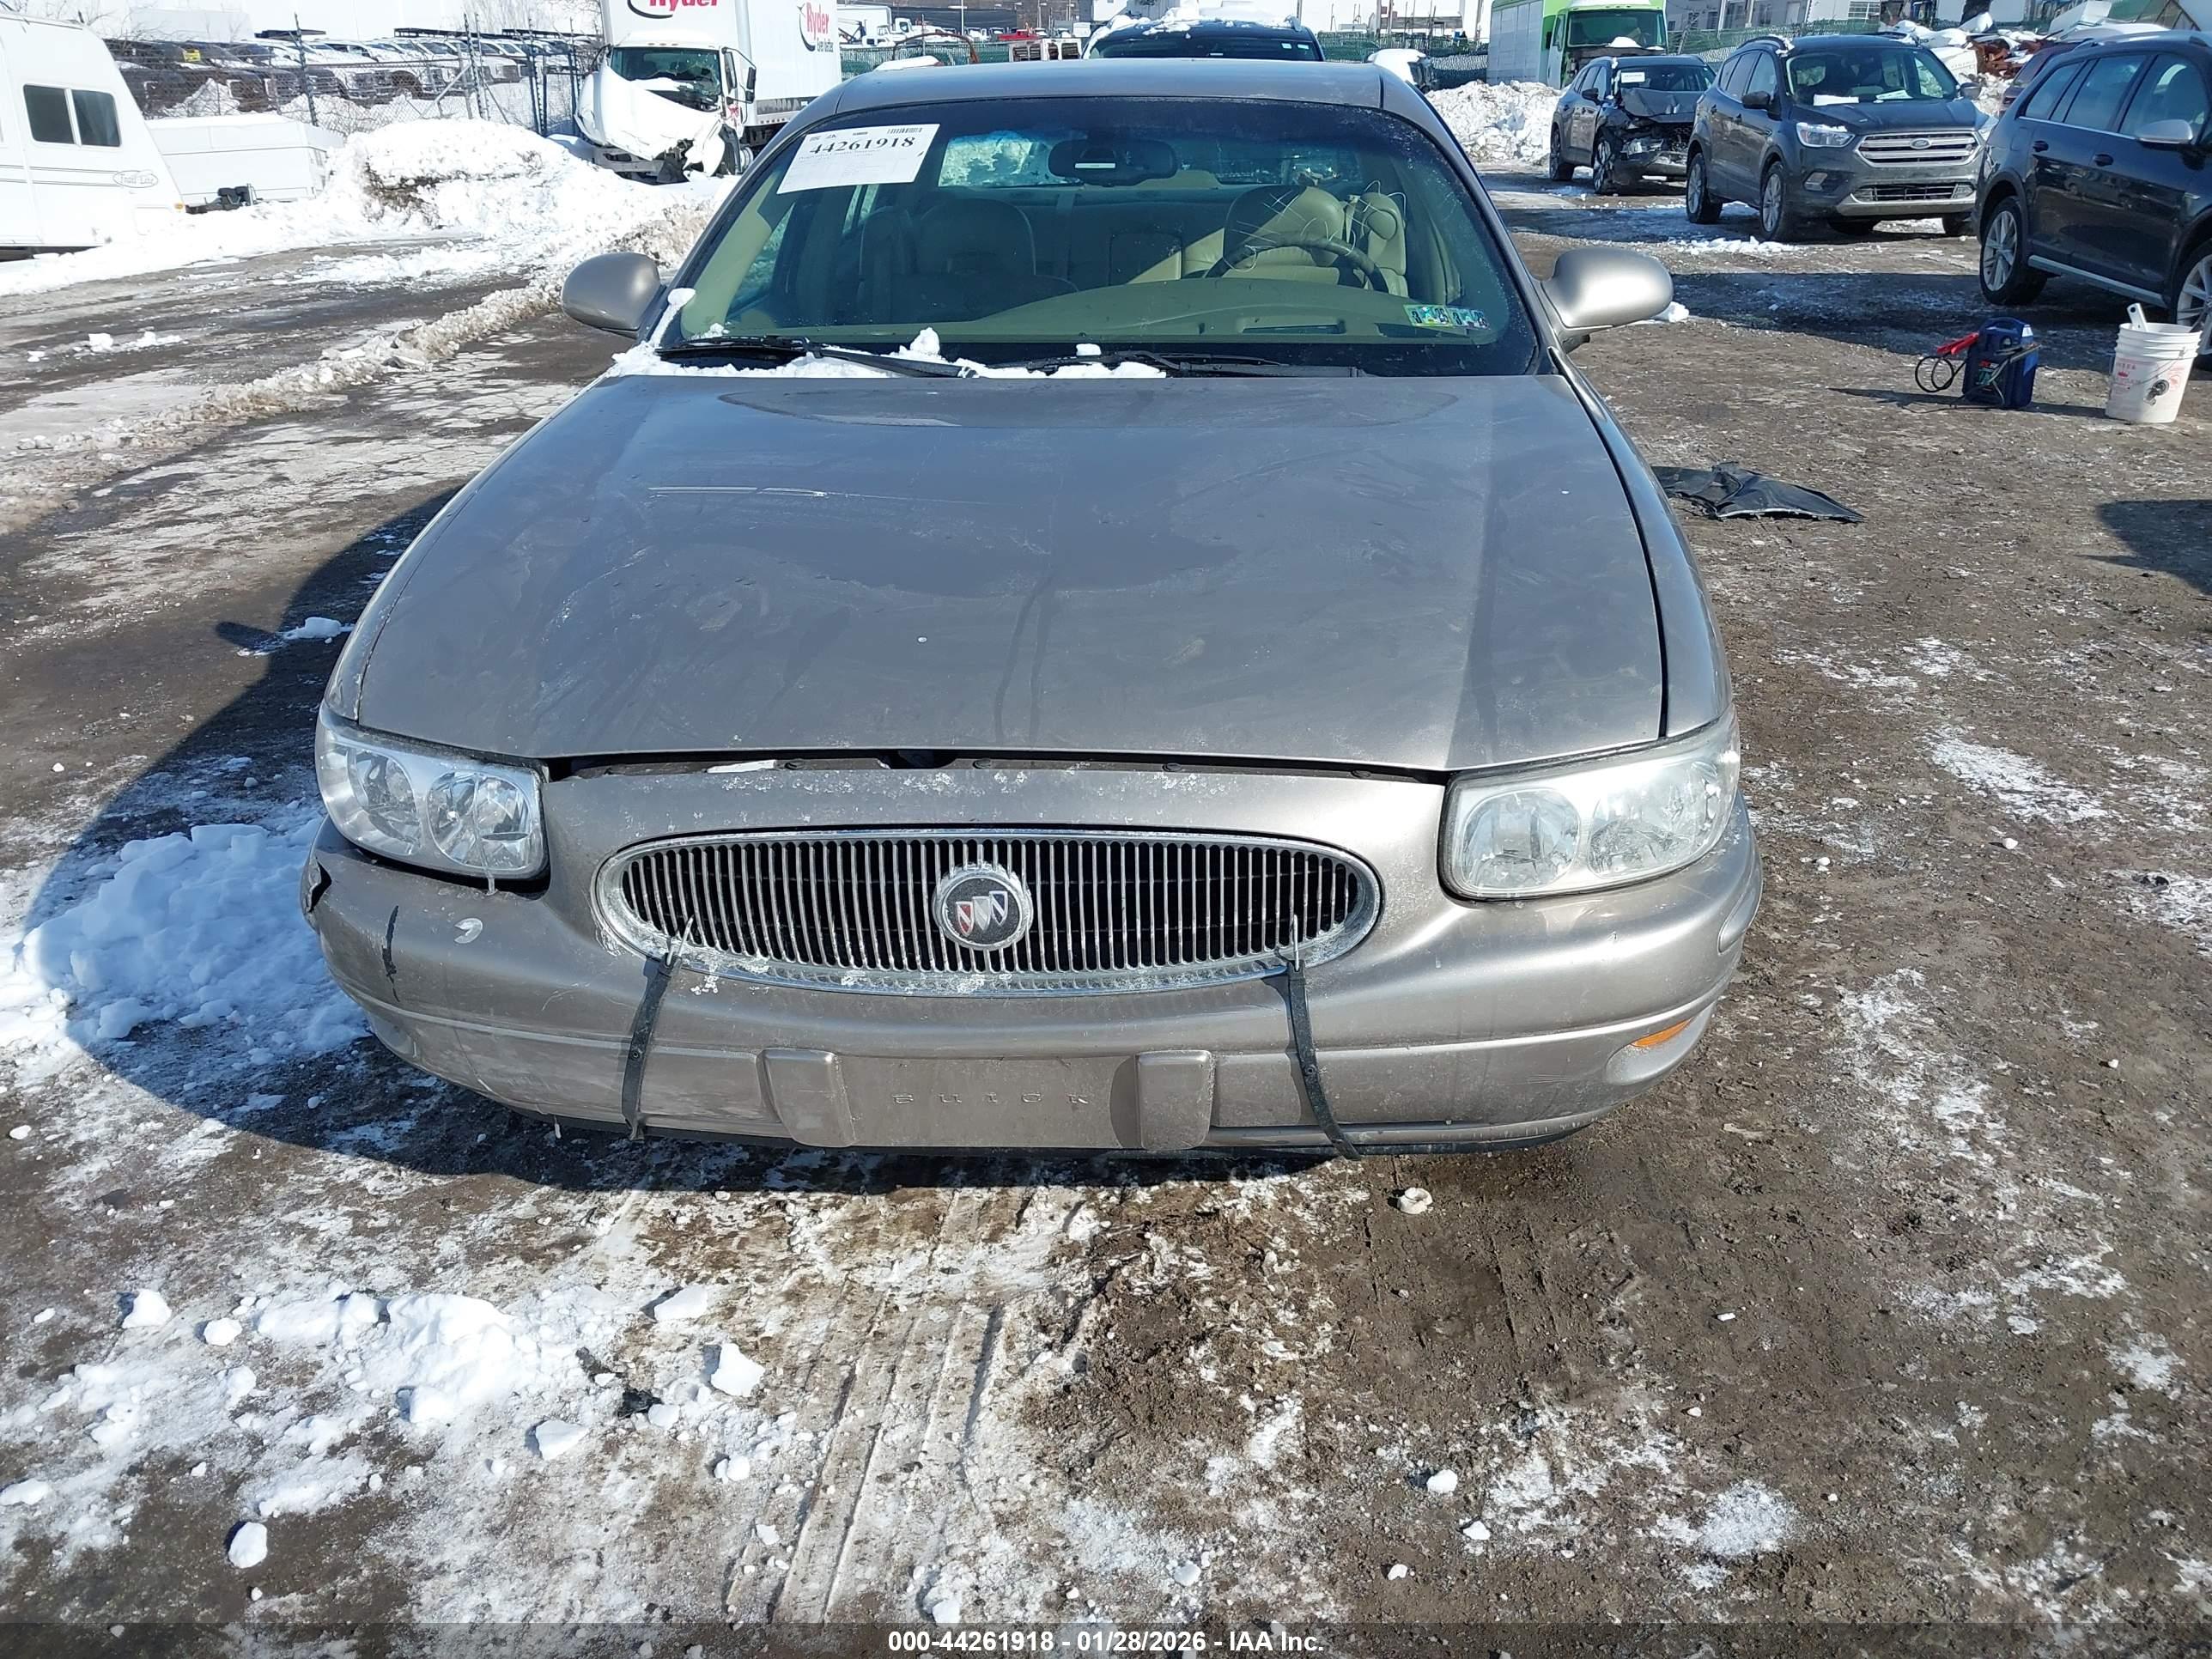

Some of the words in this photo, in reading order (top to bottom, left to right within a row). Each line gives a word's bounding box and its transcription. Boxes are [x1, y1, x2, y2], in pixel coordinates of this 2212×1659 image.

[806, 2, 830, 40] Ryder
[810, 137, 916, 154] 44261918
[892, 1092, 1090, 1104] BUICK
